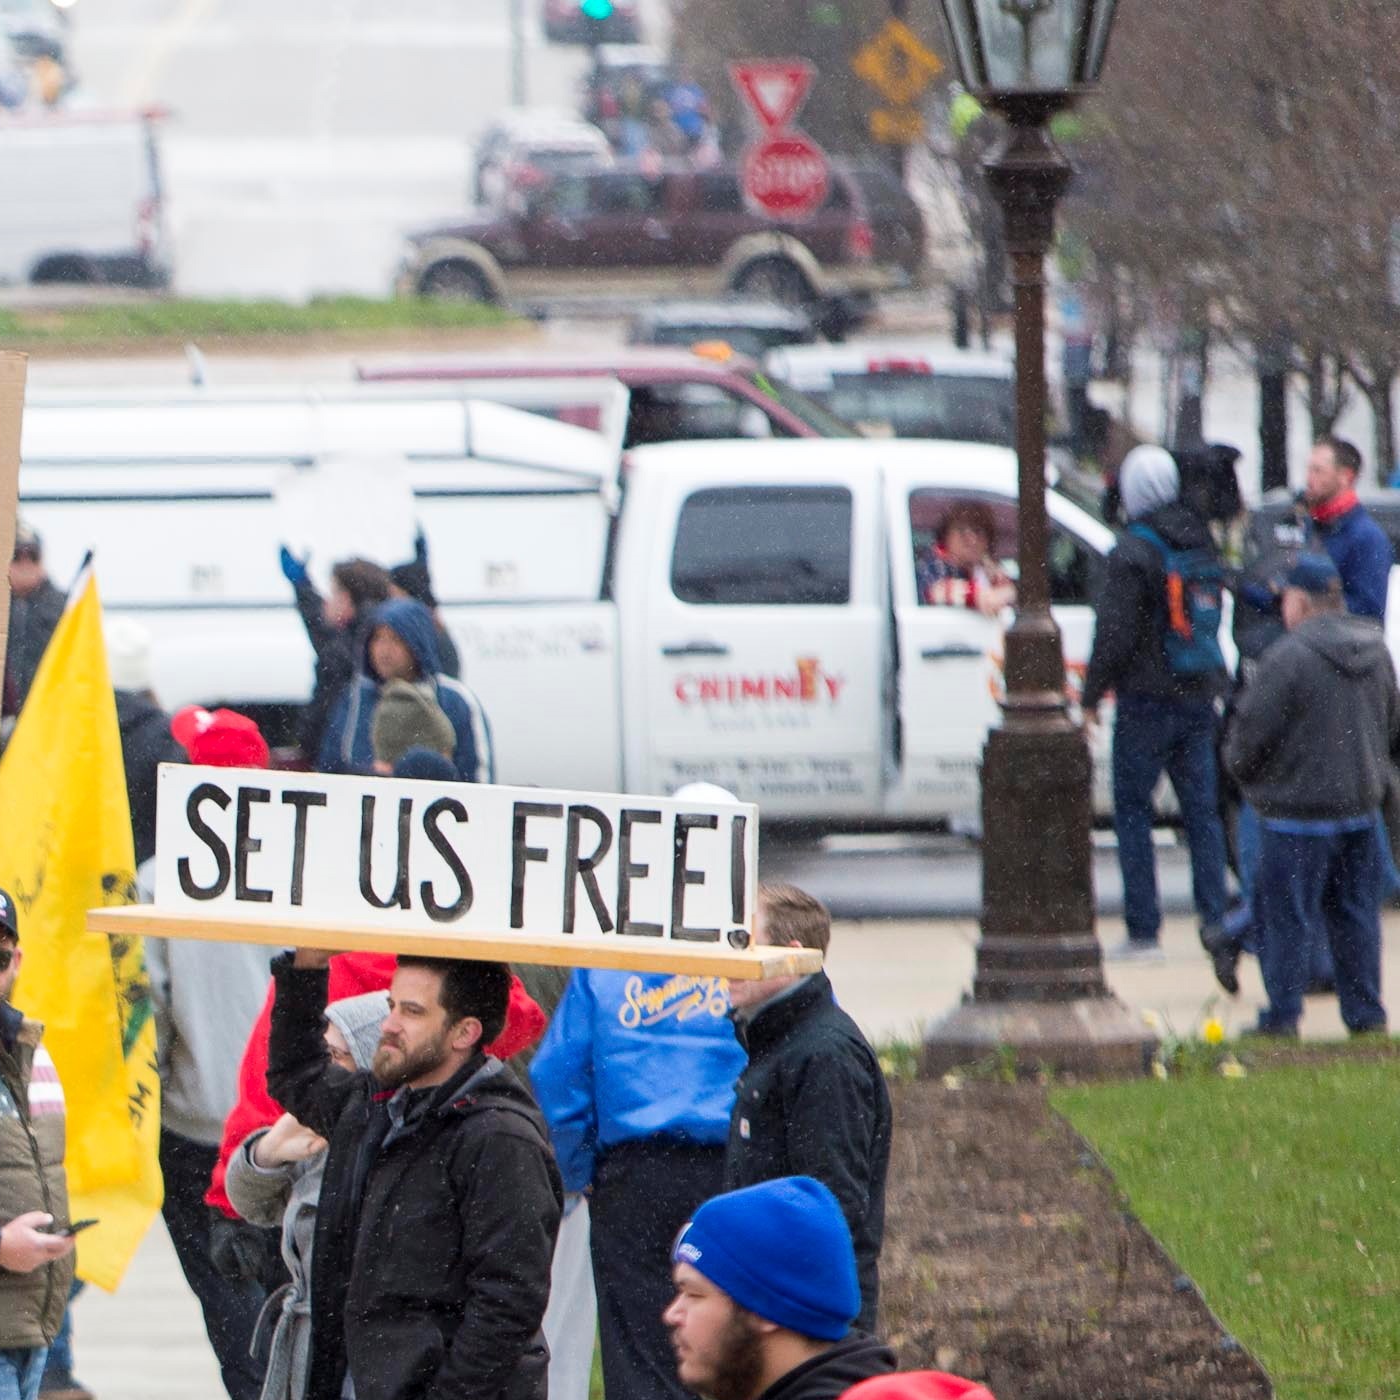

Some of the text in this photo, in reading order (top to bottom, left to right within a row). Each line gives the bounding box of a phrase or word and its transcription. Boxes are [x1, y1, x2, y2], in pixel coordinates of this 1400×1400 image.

[177, 782, 753, 951] SET US FREE!
